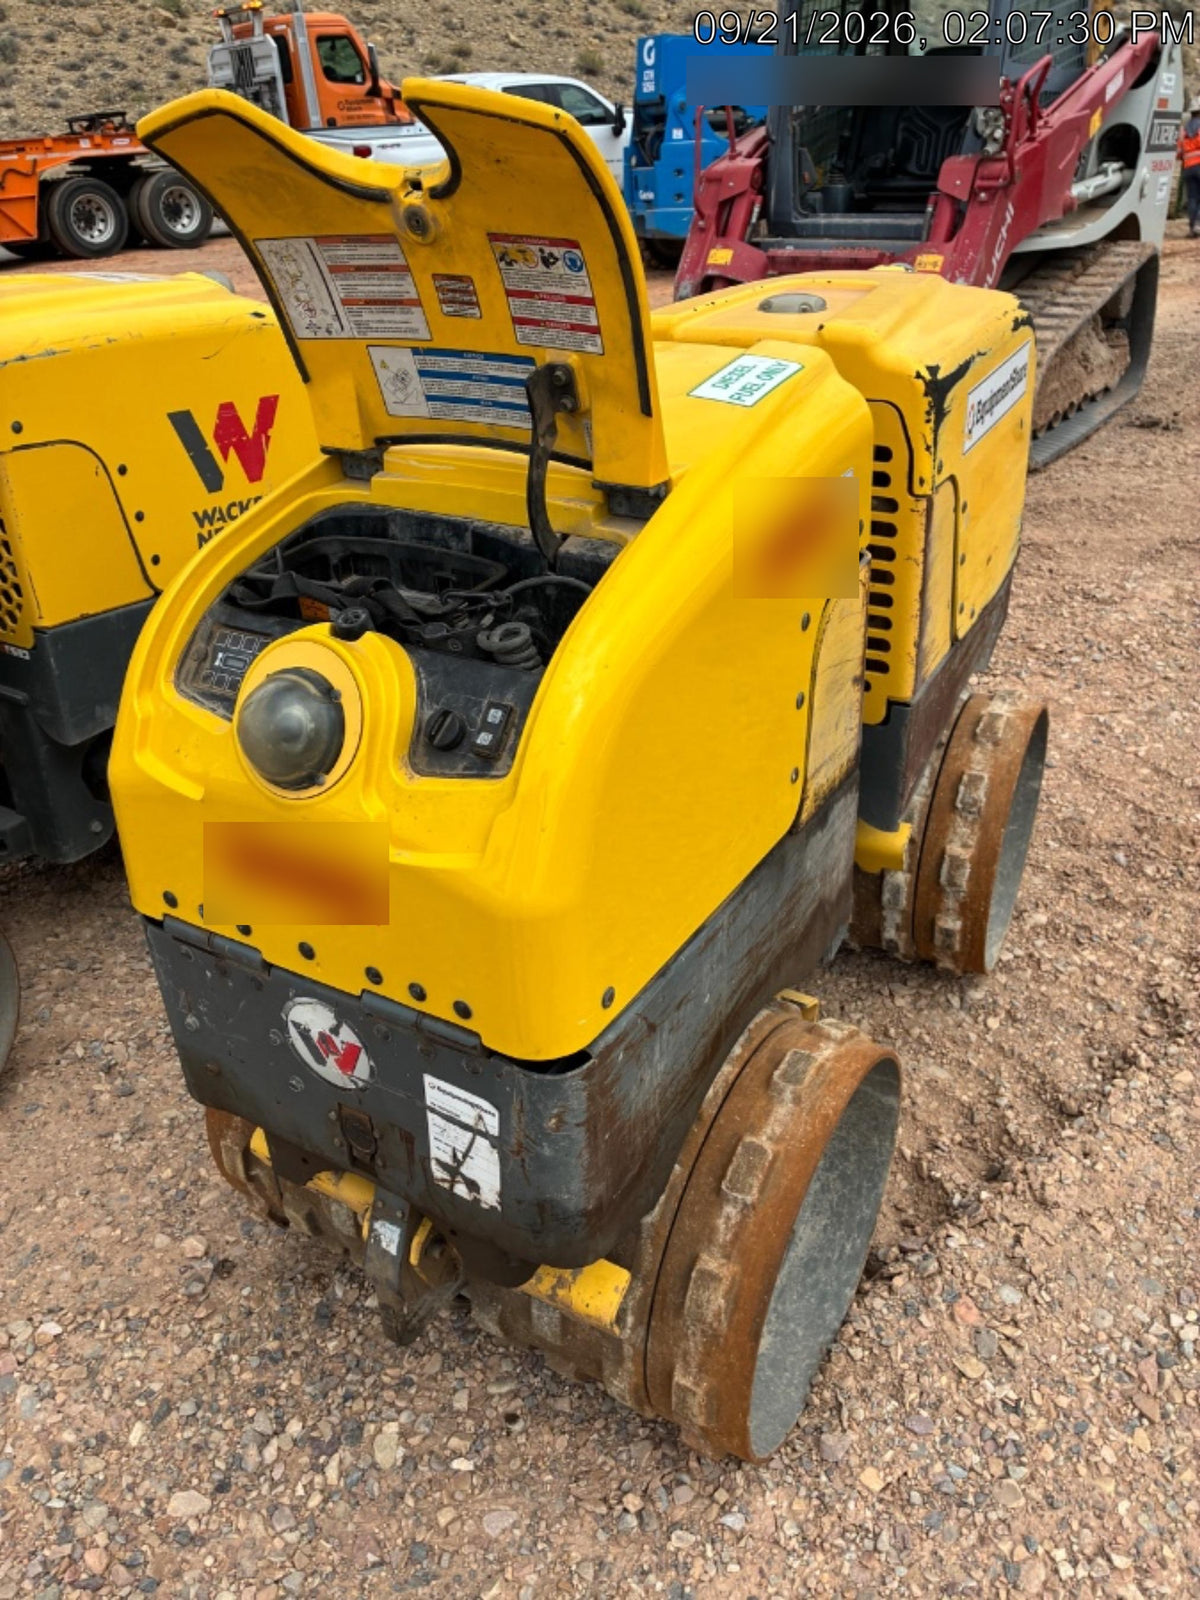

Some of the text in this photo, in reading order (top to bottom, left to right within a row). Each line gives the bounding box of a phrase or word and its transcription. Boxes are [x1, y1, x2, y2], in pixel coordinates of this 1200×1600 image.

[984, 202, 1015, 289] UCHI
[711, 364, 757, 390] DIESEL
[728, 361, 790, 402] FUEL ONLY
